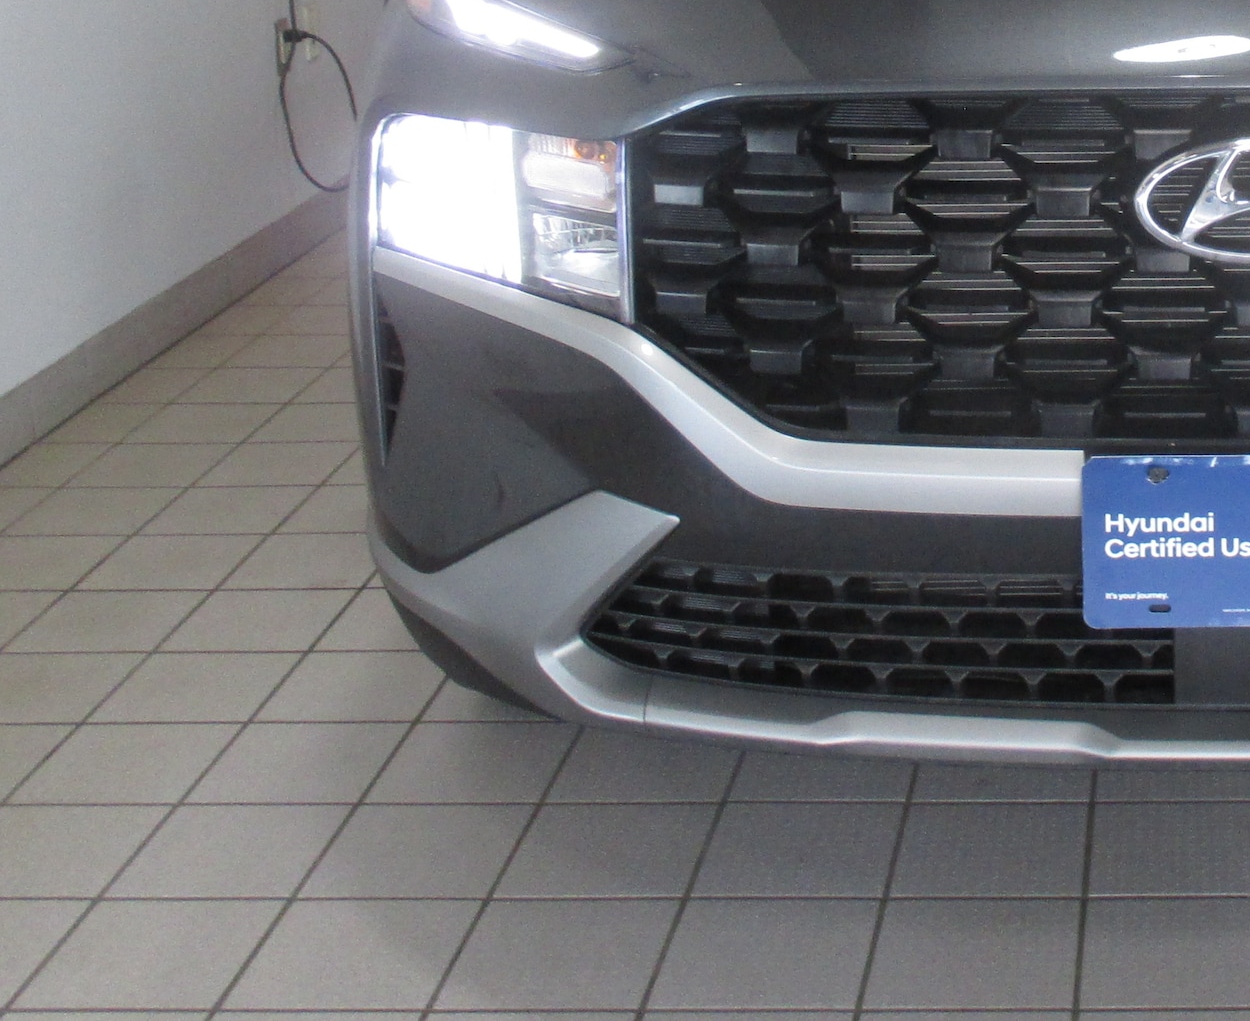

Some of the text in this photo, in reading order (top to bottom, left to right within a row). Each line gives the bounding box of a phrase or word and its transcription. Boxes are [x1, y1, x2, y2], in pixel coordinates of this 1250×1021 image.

[1104, 512, 1215, 537] Hyundai
[1104, 537, 1215, 558] Certified
[1118, 593, 1137, 601] your
